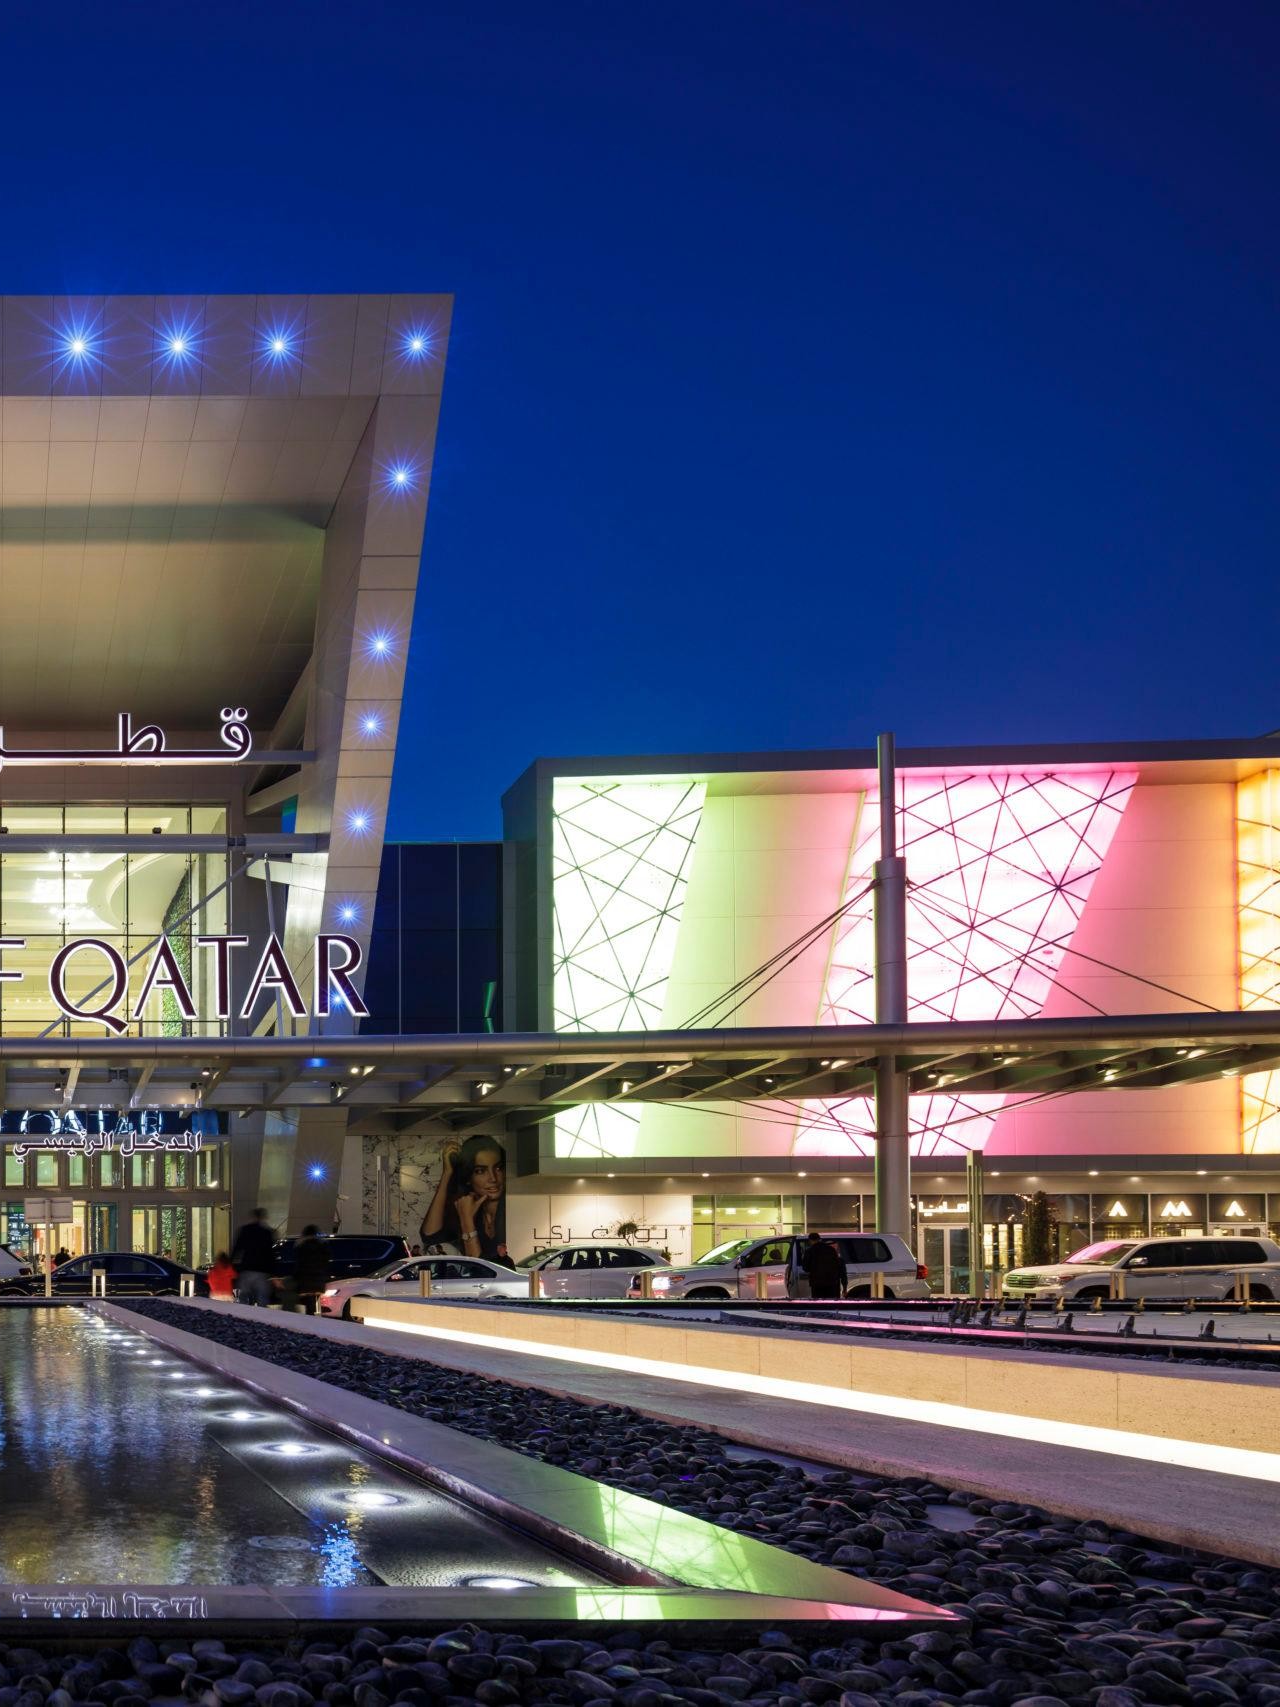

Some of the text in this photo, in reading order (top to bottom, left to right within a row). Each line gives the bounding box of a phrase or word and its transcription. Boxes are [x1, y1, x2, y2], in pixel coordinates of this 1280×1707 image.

[48, 931, 371, 1036] QATAR
[13, 1128, 203, 1163] المدخل الرئيسي
